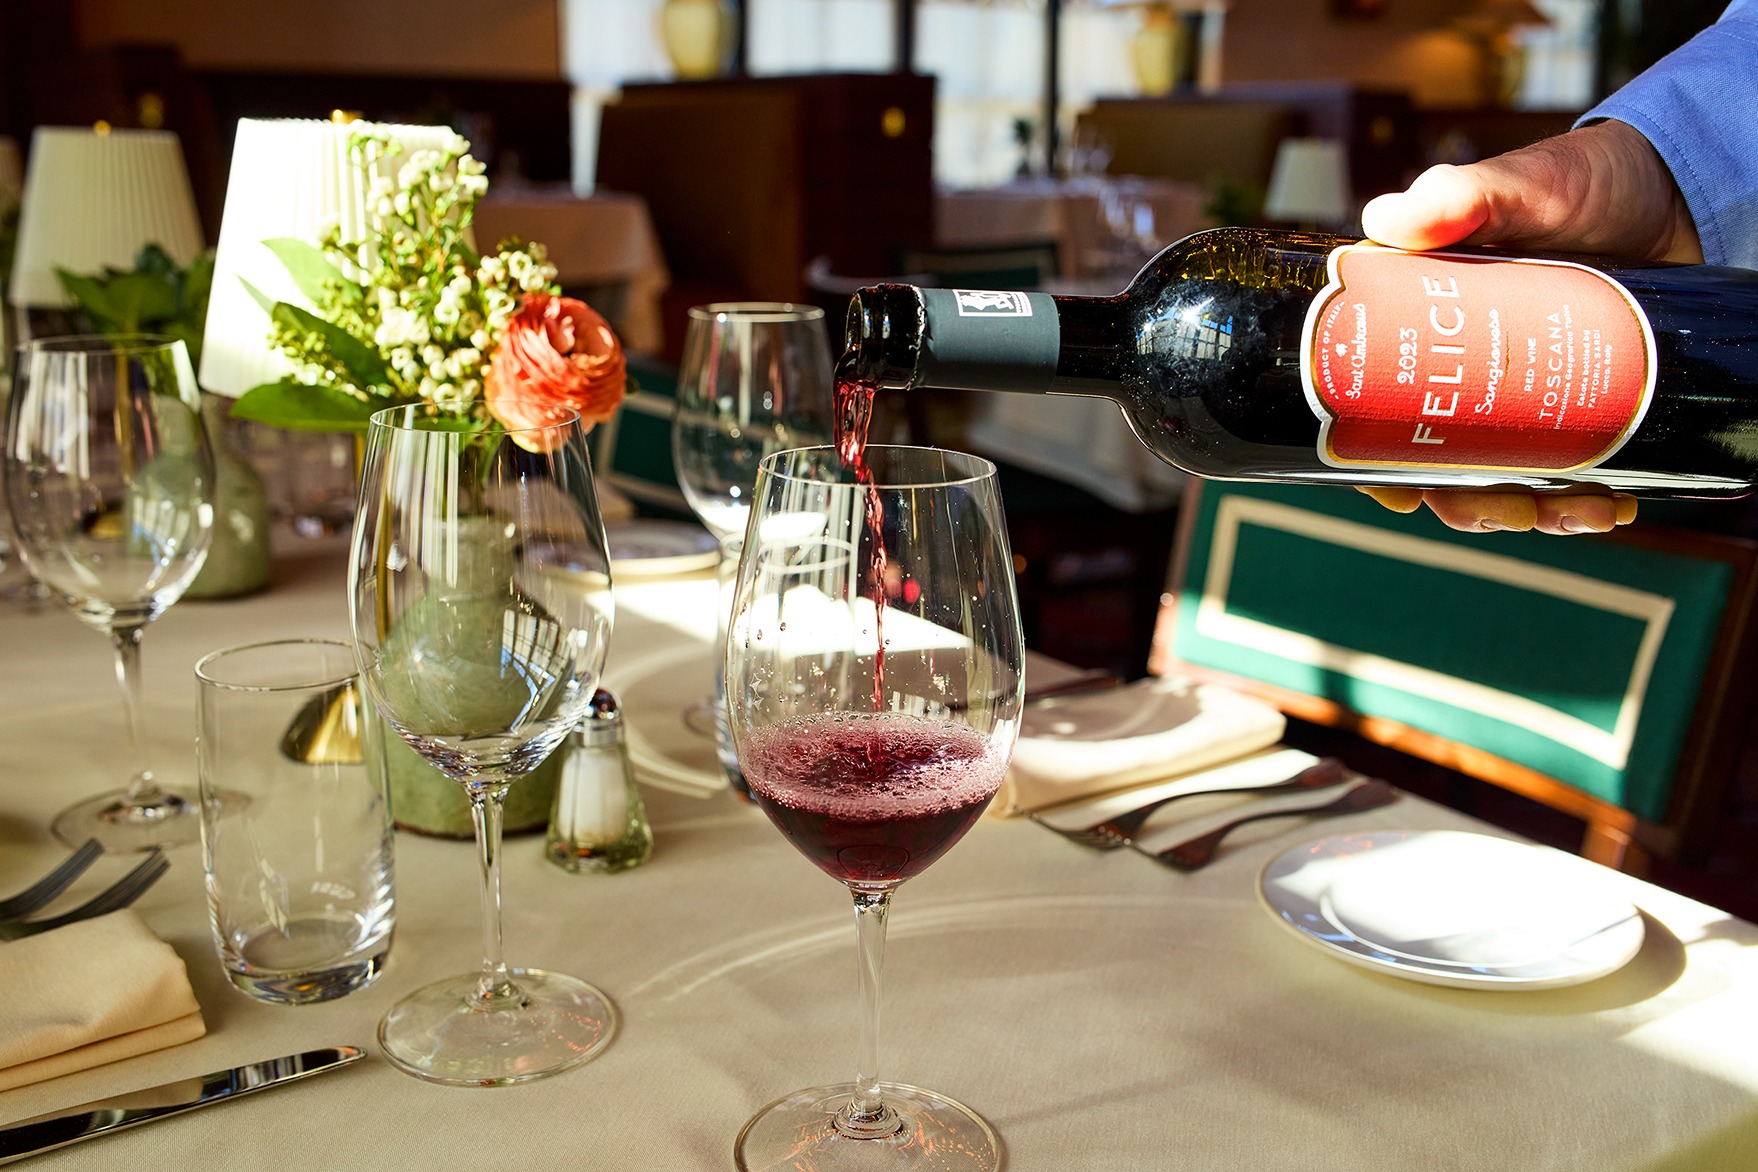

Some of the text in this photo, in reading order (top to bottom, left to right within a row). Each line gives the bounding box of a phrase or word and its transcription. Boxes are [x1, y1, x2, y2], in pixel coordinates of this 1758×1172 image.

[1322, 304, 1341, 394] PRODUCT OF ITALY
[1345, 369, 1364, 400] Sant
[1396, 327, 1418, 385] 2023
[1411, 275, 1465, 445] FELICE
[1475, 308, 1504, 416] Sangiovese
[1524, 338, 1536, 392] RED WINE
[1538, 312, 1563, 420] TOSCANA
[1554, 382, 1572, 430] Indicazione
[1565, 331, 1575, 380] Geografica
[1577, 330, 1591, 406] Estate bottled by
[1588, 362, 1600, 408] FATTORIA
[1604, 344, 1613, 365] Italy
